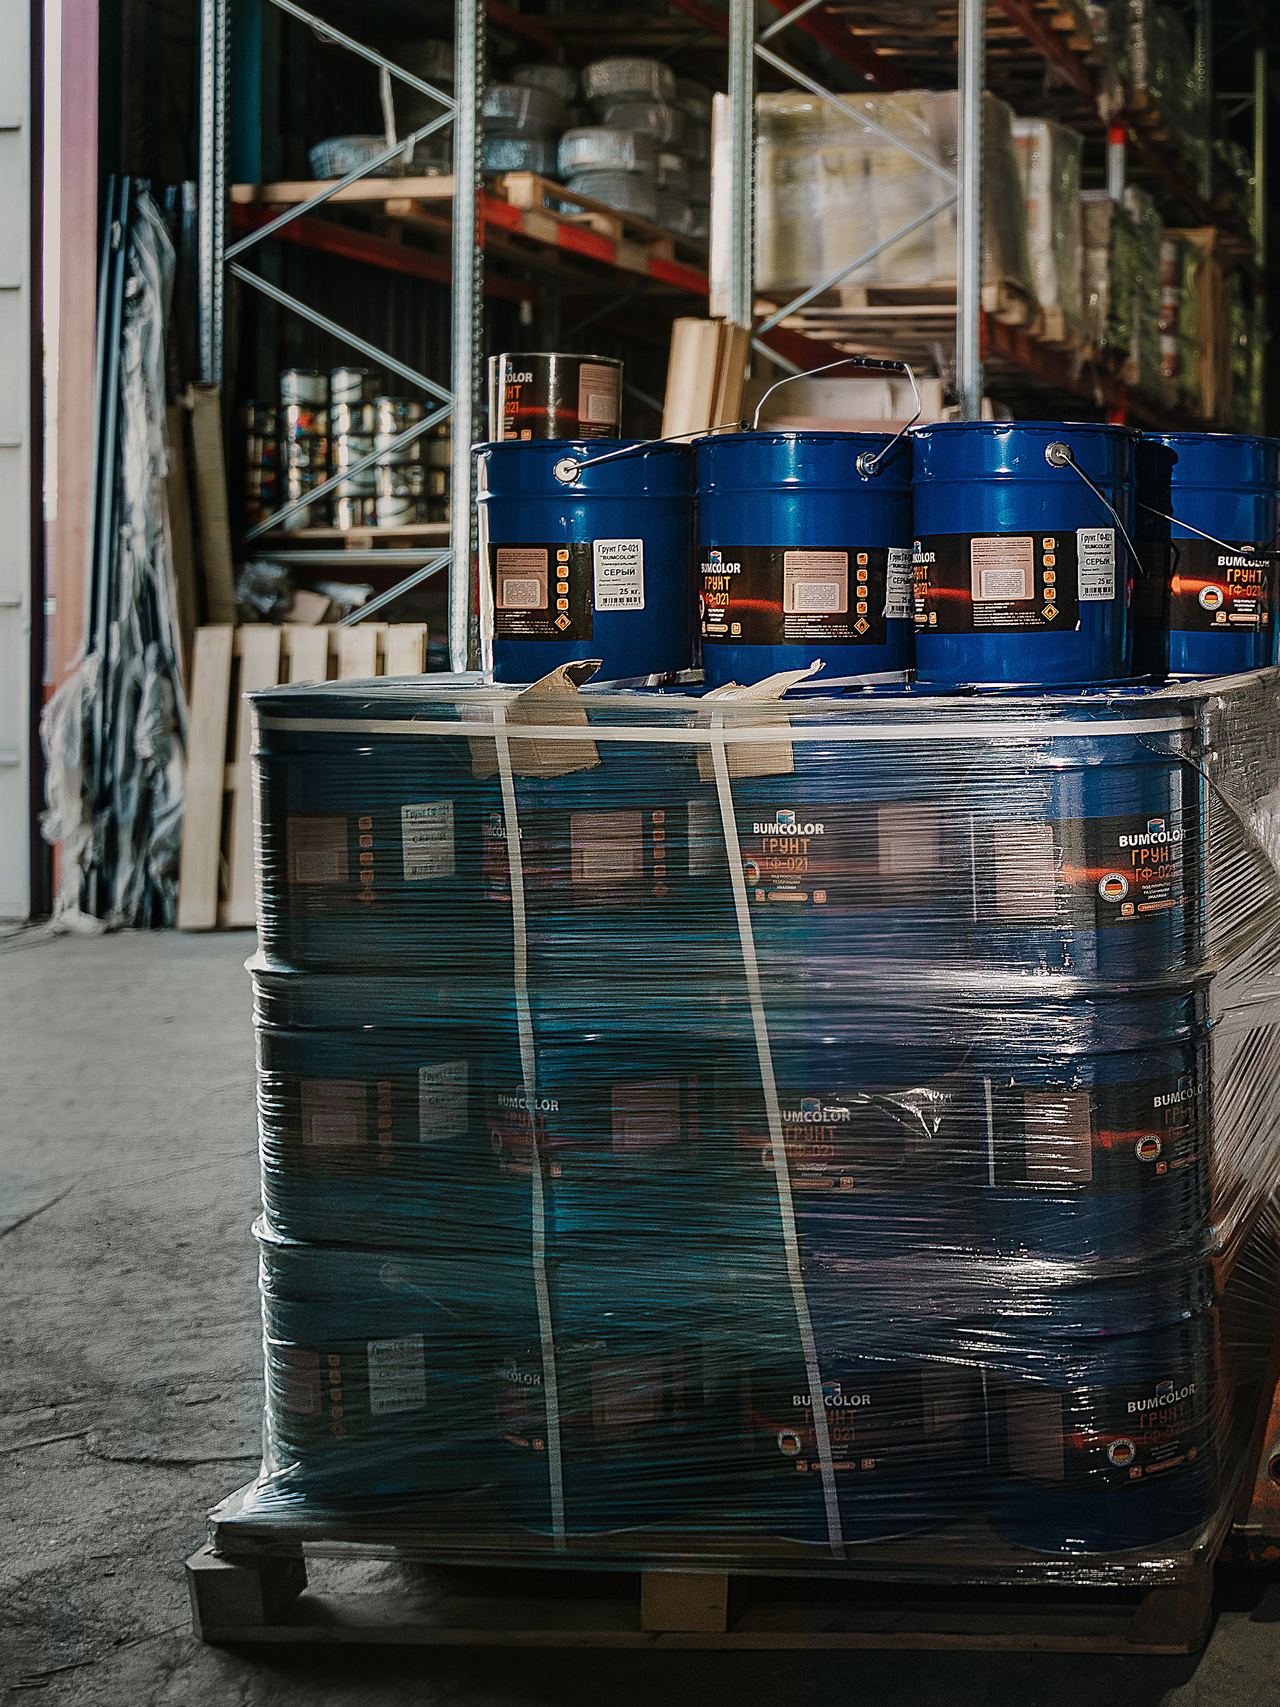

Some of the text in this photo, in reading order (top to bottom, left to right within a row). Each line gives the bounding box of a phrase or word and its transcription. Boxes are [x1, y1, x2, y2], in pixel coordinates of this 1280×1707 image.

[505, 372, 533, 383] COLOR
[598, 544, 639, 554] Грунт ГФ-021
[1086, 557, 1110, 565] СЕРЫЙ
[604, 567, 636, 576] СЕРЫЙ
[1226, 569, 1263, 583] ГРУНТ
[704, 576, 731, 591] ГРУНТ
[1228, 584, 1261, 596] ГФ-021
[753, 822, 825, 835] BUMCOLOR
[762, 837, 811, 855] ГРУНТ
[1131, 845, 1178, 866] ГРУНТ
[765, 857, 808, 871] ГФ-021
[780, 1110, 851, 1122] UMCOLOR
[785, 1125, 838, 1142] ГРУНТ
[793, 1394, 871, 1407] BUCOLOR
[1127, 1383, 1195, 1413] BUMCOLOR
[1140, 1402, 1185, 1429] ГРУНТ
